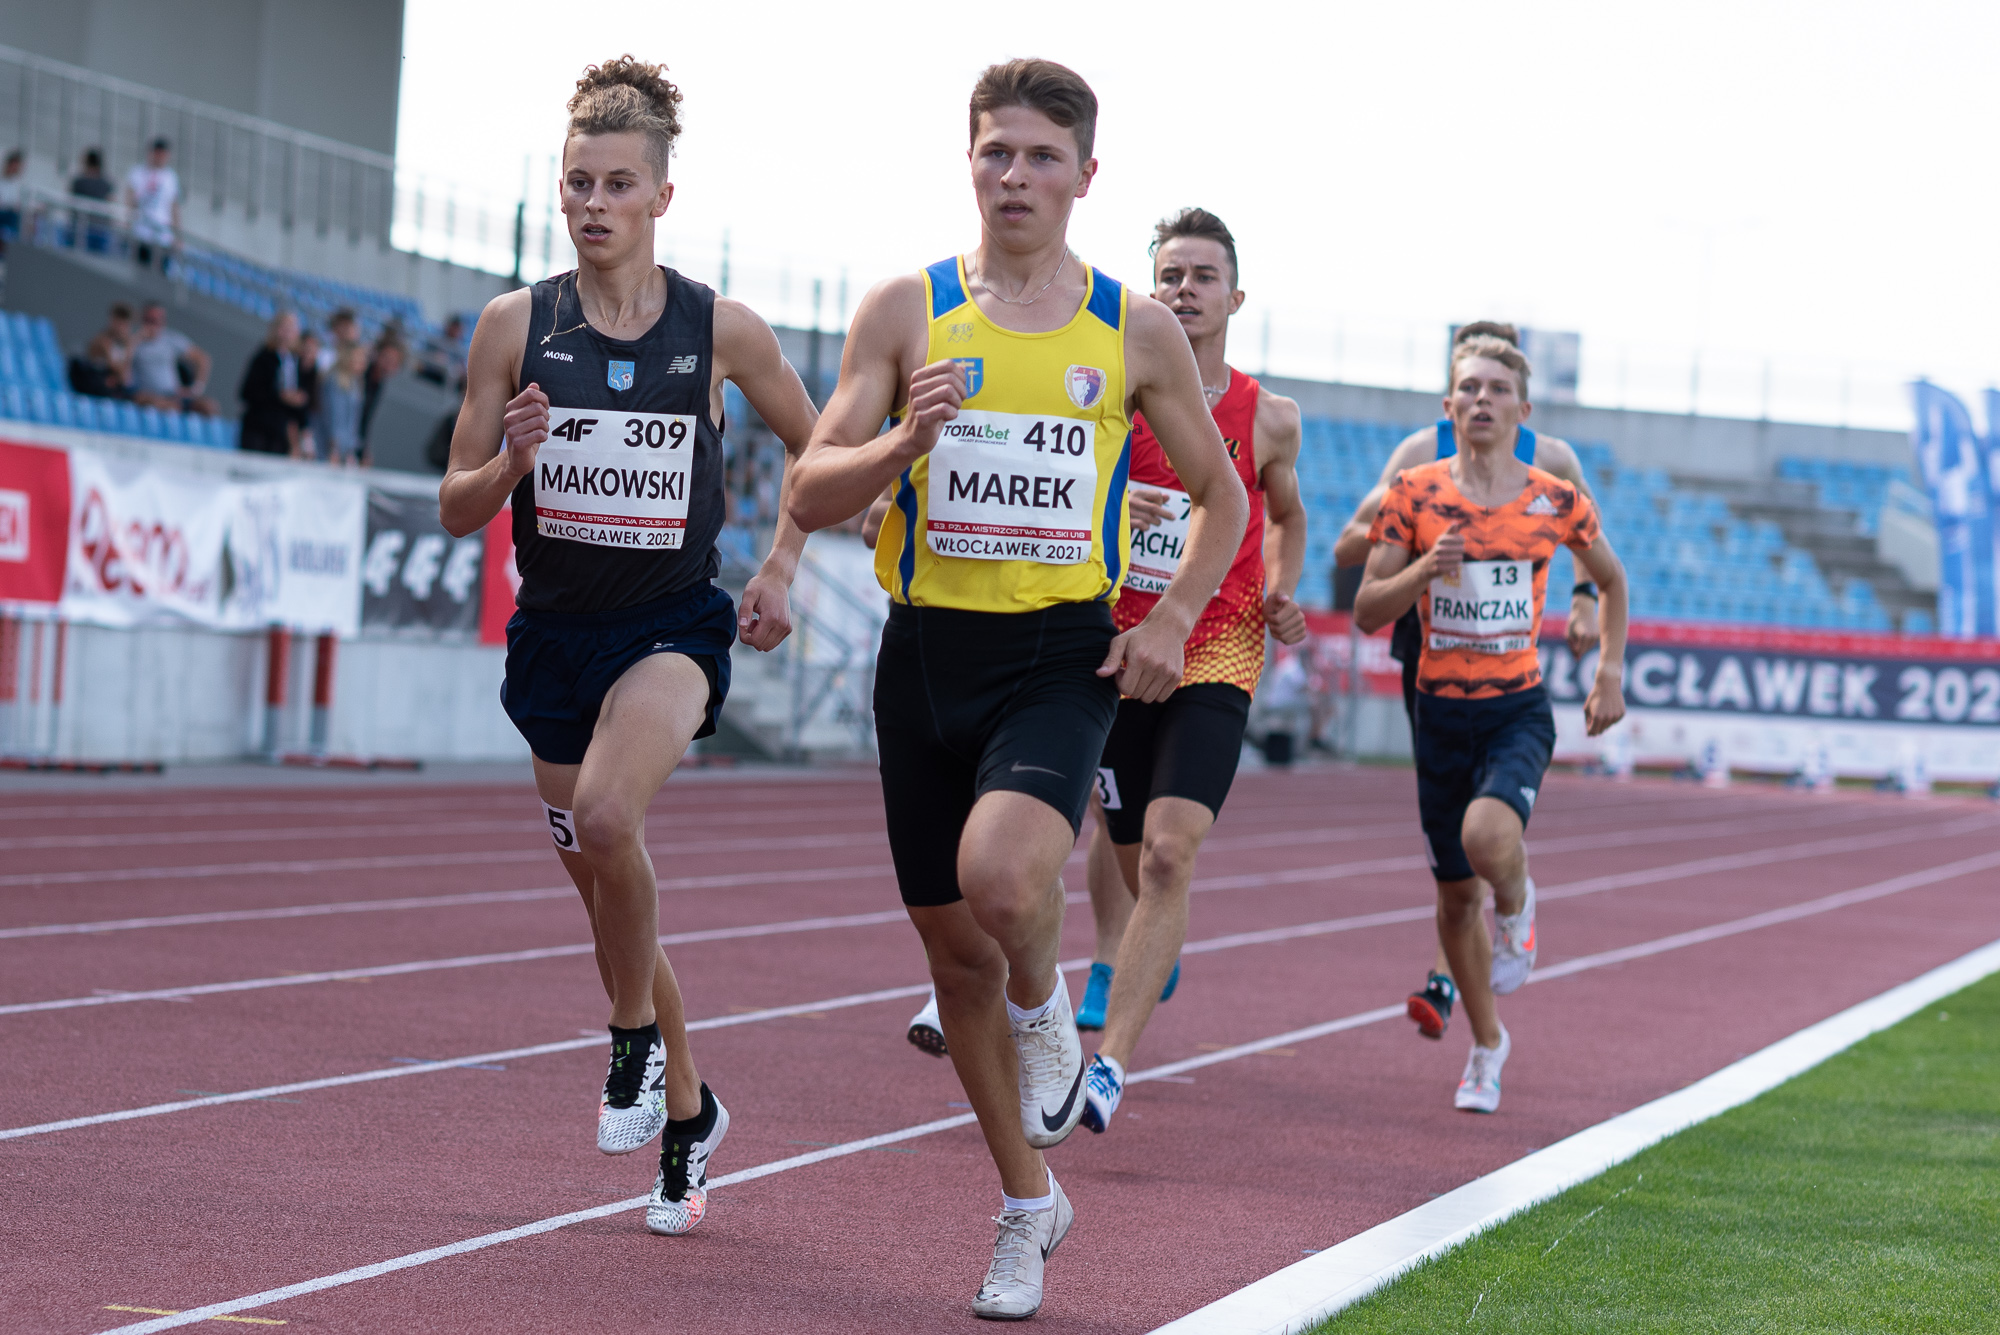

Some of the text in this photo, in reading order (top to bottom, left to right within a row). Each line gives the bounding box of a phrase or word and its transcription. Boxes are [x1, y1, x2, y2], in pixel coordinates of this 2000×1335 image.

[551, 417, 599, 442] 4F
[623, 418, 688, 450] 309
[944, 423, 1011, 441] TOTALbet
[1023, 421, 1086, 457] 410
[541, 462, 685, 501] MAKOWSKI
[948, 470, 1077, 510] MAREK
[557, 511, 577, 520] PZLA
[578, 514, 637, 525] MISTRZOSTWA
[639, 519, 667, 527] POLSKI
[933, 522, 1085, 539] 53. PZLA MISTRZOSTWA POLSKI U18
[544, 522, 676, 546] WŁOCŁAWEK 2021
[1130, 528, 1187, 560] ĄCH
[934, 536, 1082, 560] WŁOCŁAWEK 2021
[1124, 573, 1171, 593] OCŁAW
[1491, 565, 1518, 586] 13
[1434, 596, 1529, 620] FRANCZAK
[547, 807, 574, 848] 5
